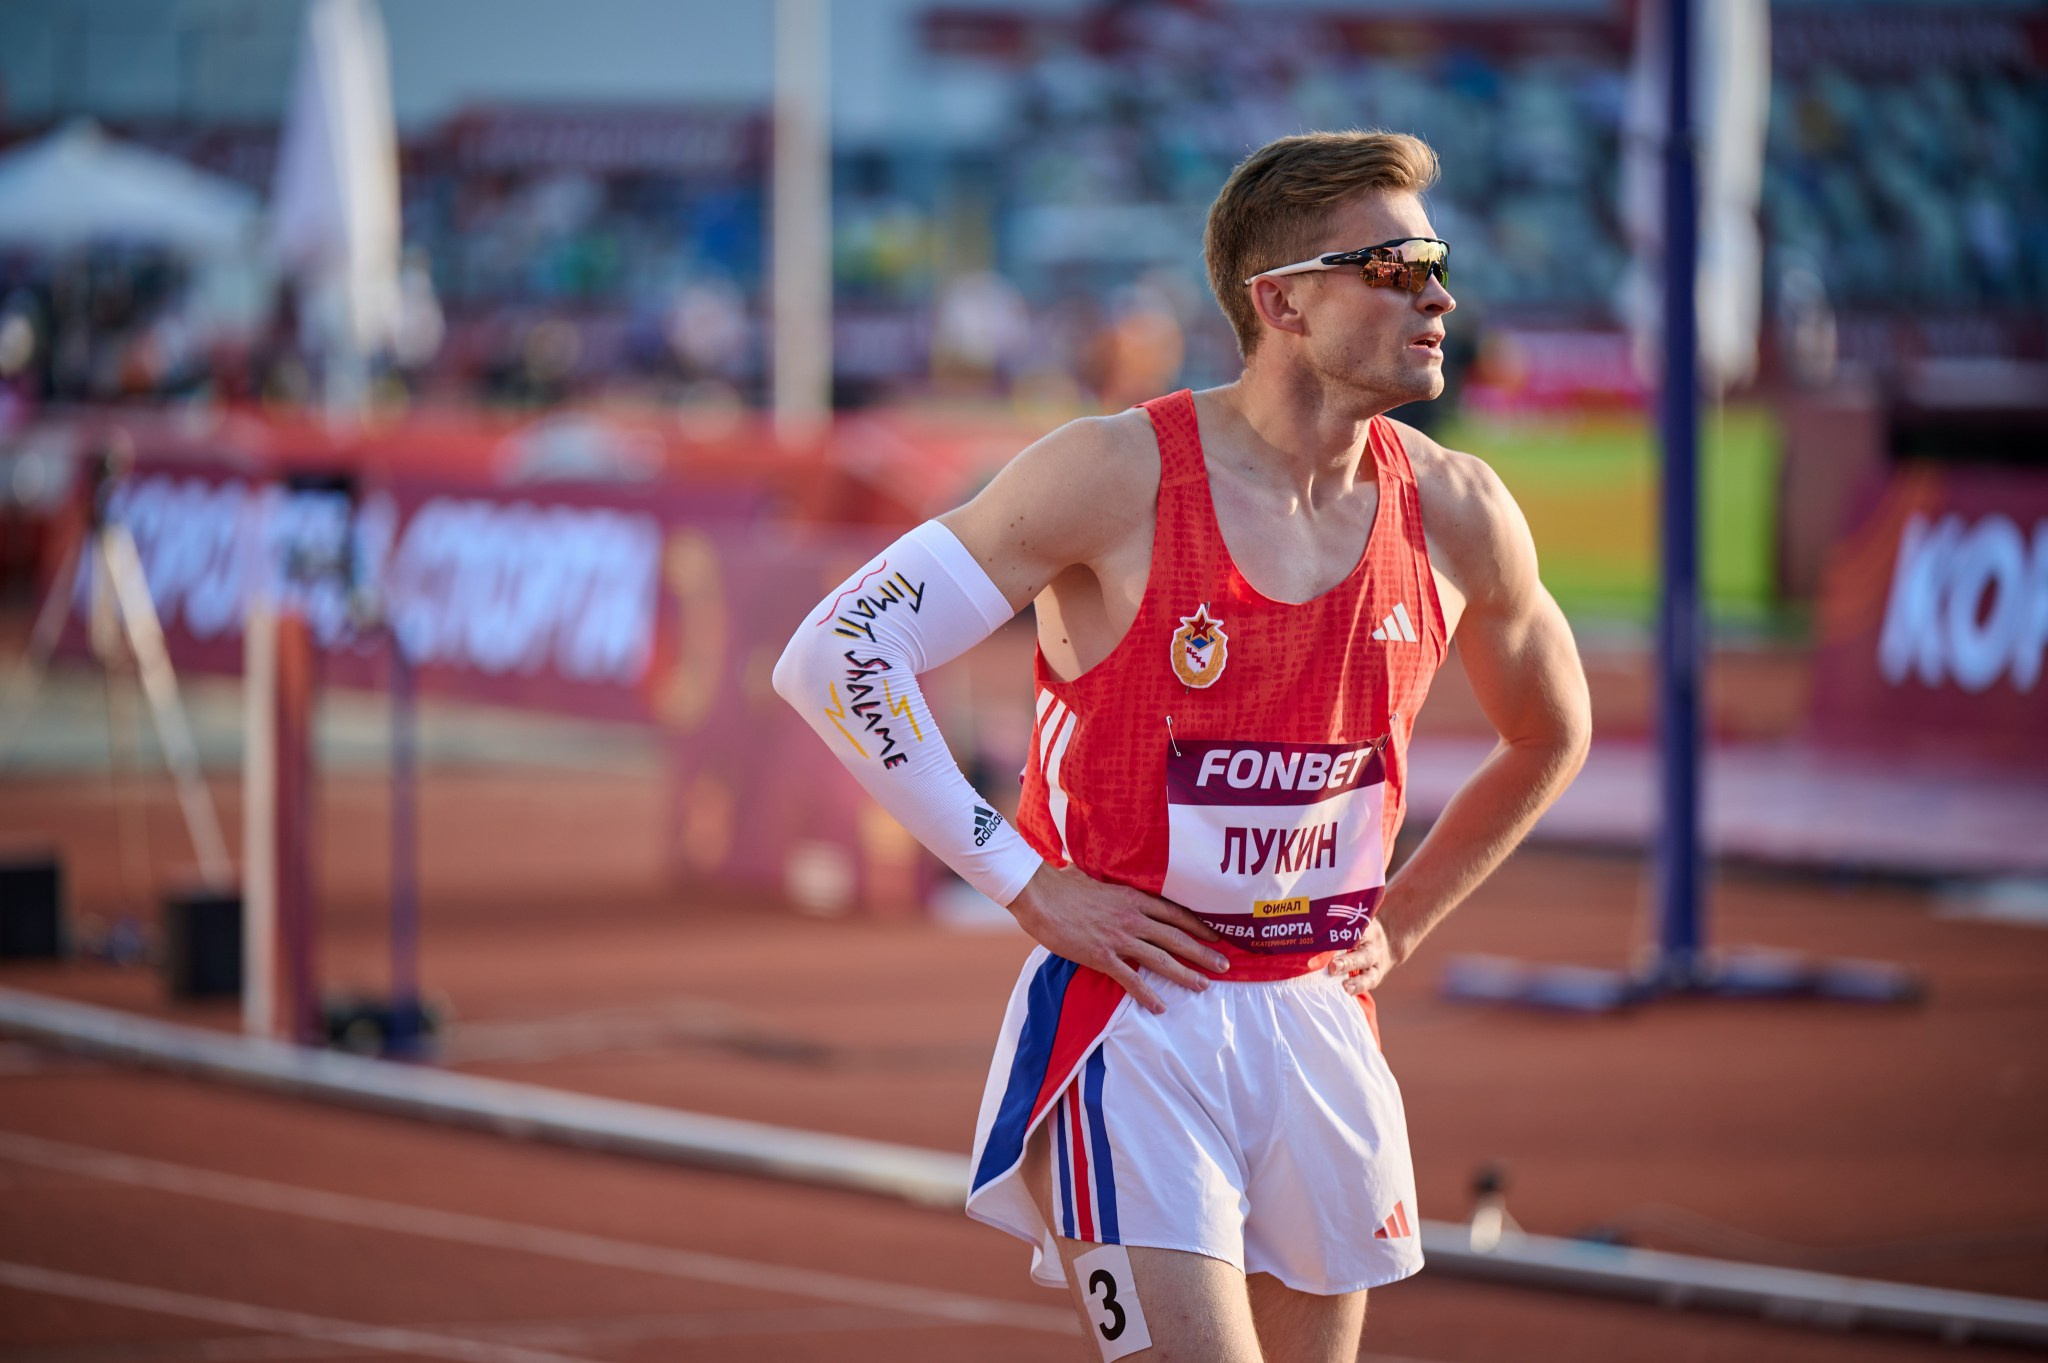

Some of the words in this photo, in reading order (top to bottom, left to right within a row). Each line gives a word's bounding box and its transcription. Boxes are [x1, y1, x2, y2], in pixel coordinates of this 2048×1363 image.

[1196, 747, 1373, 791] FONBET
[975, 812, 1003, 847] adidas
[1220, 821, 1338, 876] ЛУКИН
[1262, 900, 1301, 915] ФИНАЛ
[1251, 938, 1296, 948] ЕКАТЕРИНБУРГ
[1299, 937, 1314, 945] 2025
[1261, 922, 1313, 937] СПОРТА
[1089, 1268, 1126, 1342] 3
